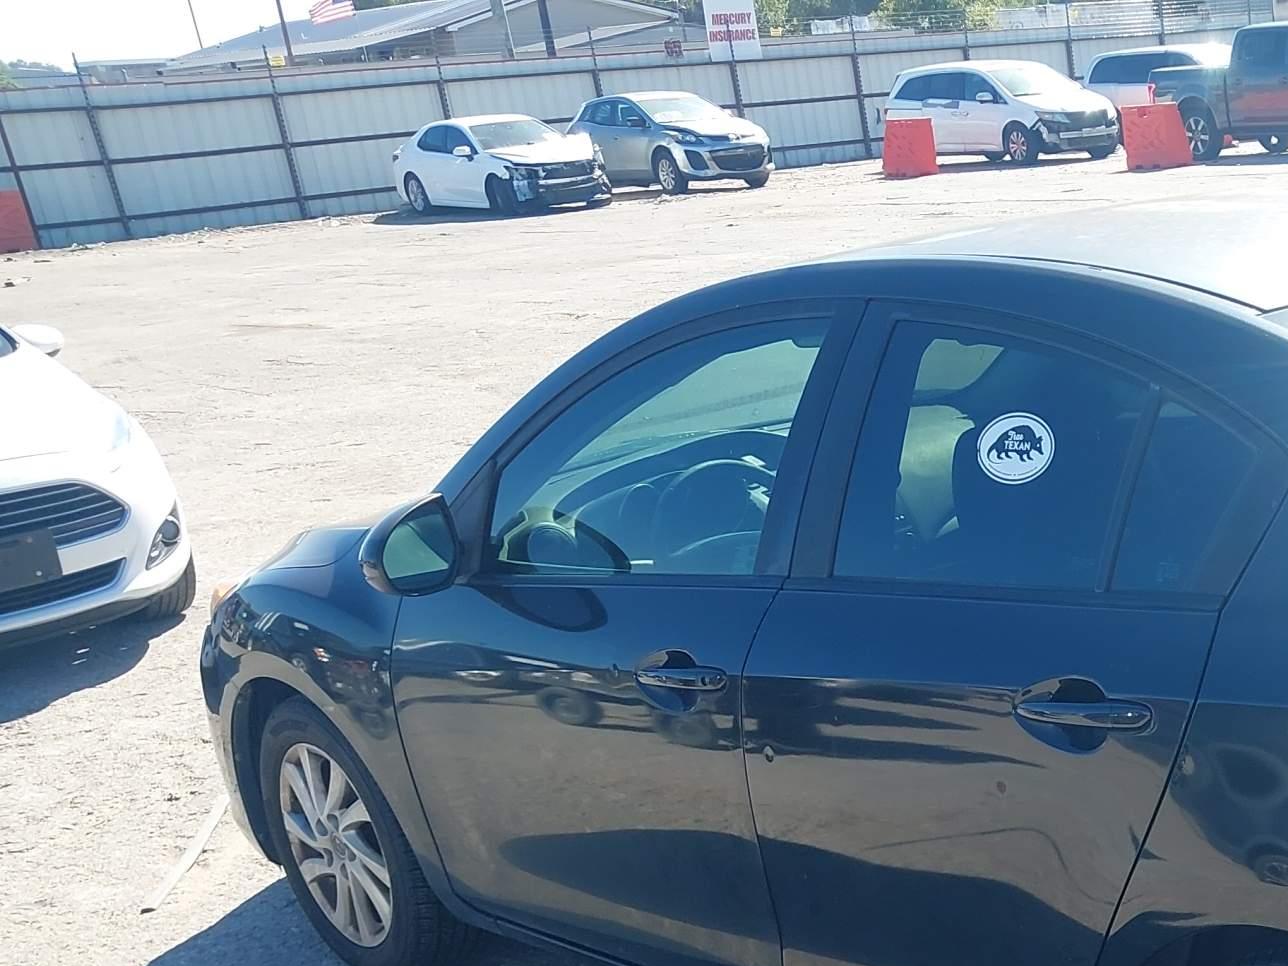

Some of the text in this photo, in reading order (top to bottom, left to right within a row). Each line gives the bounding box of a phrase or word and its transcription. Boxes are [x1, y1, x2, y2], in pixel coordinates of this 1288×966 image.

[711, 12, 752, 26] MERCURY
[709, 28, 756, 42] INSURANCE
[1004, 440, 1031, 451] TEXAN
